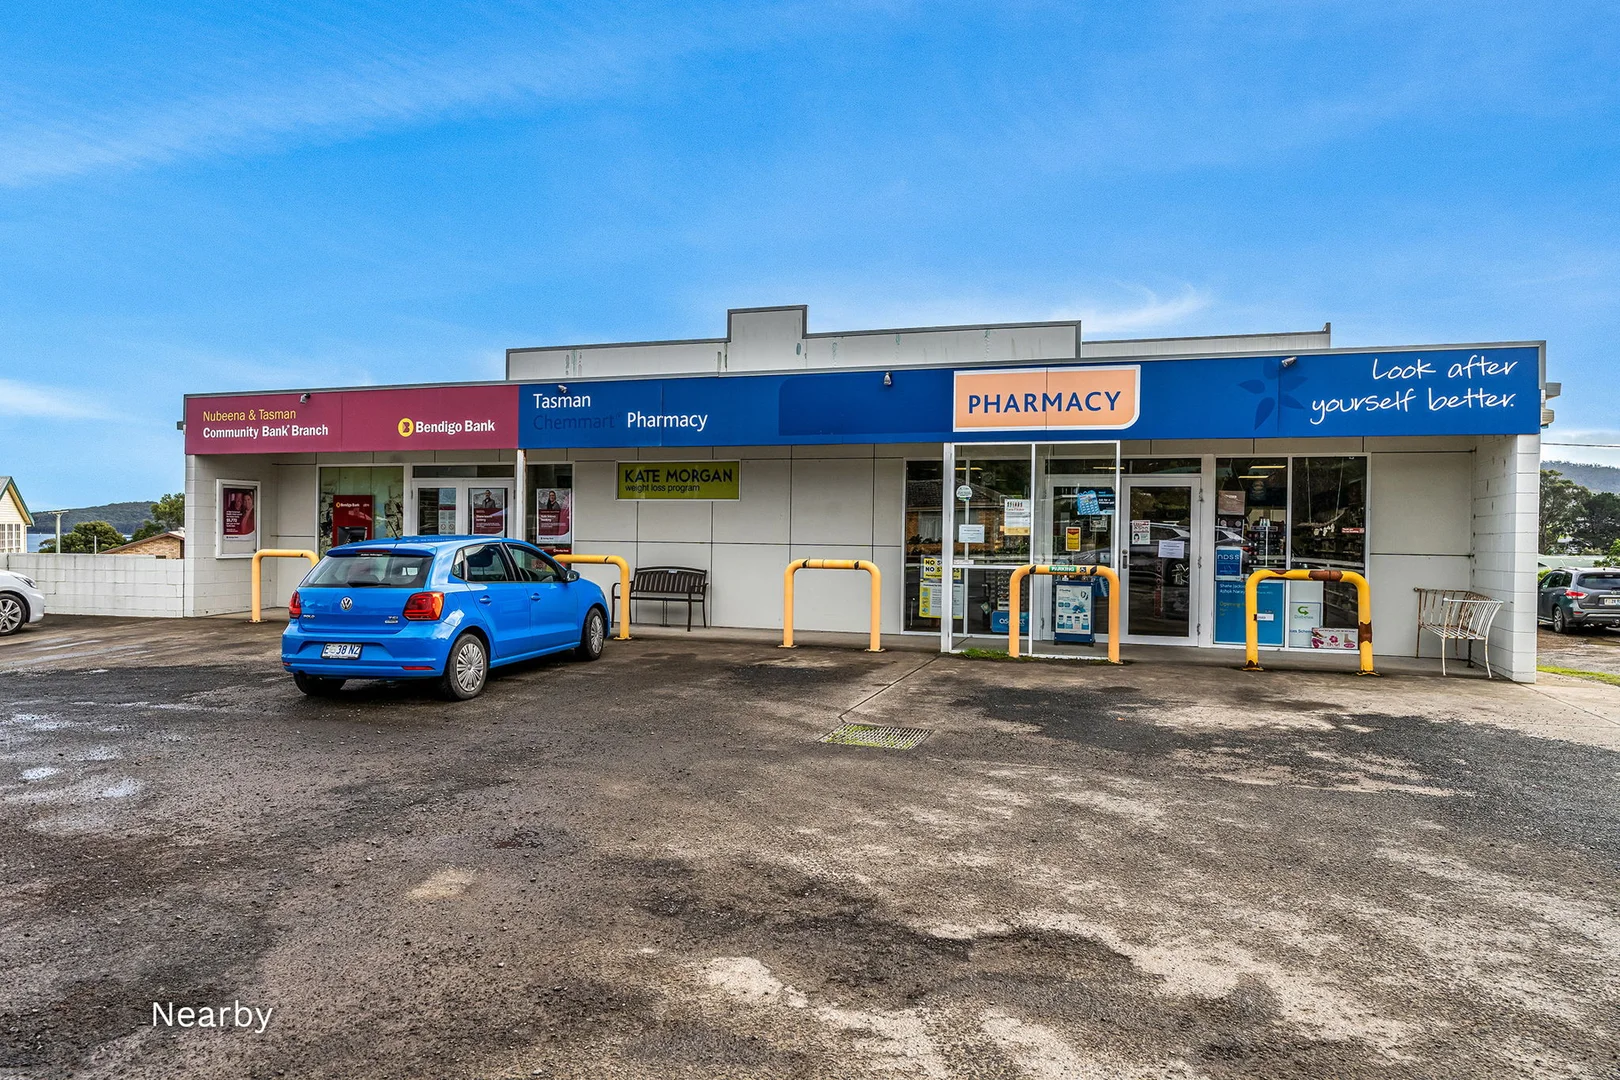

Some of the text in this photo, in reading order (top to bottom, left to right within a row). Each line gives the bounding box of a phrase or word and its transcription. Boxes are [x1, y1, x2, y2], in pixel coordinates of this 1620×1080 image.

[1372, 354, 1518, 380] Look after
[533, 393, 591, 409] Tasman
[968, 390, 1121, 414] PHARMACY
[1309, 387, 1517, 425] yourself better.
[203, 408, 297, 422] Nubeena & Tasman
[627, 411, 708, 432] Pharmacy
[203, 426, 259, 439] Community
[291, 424, 329, 436] Branch
[415, 421, 463, 435] Bendigo
[464, 419, 496, 432] Bank
[625, 468, 733, 482] KATE MORGAN
[625, 484, 700, 494] weight loss program
